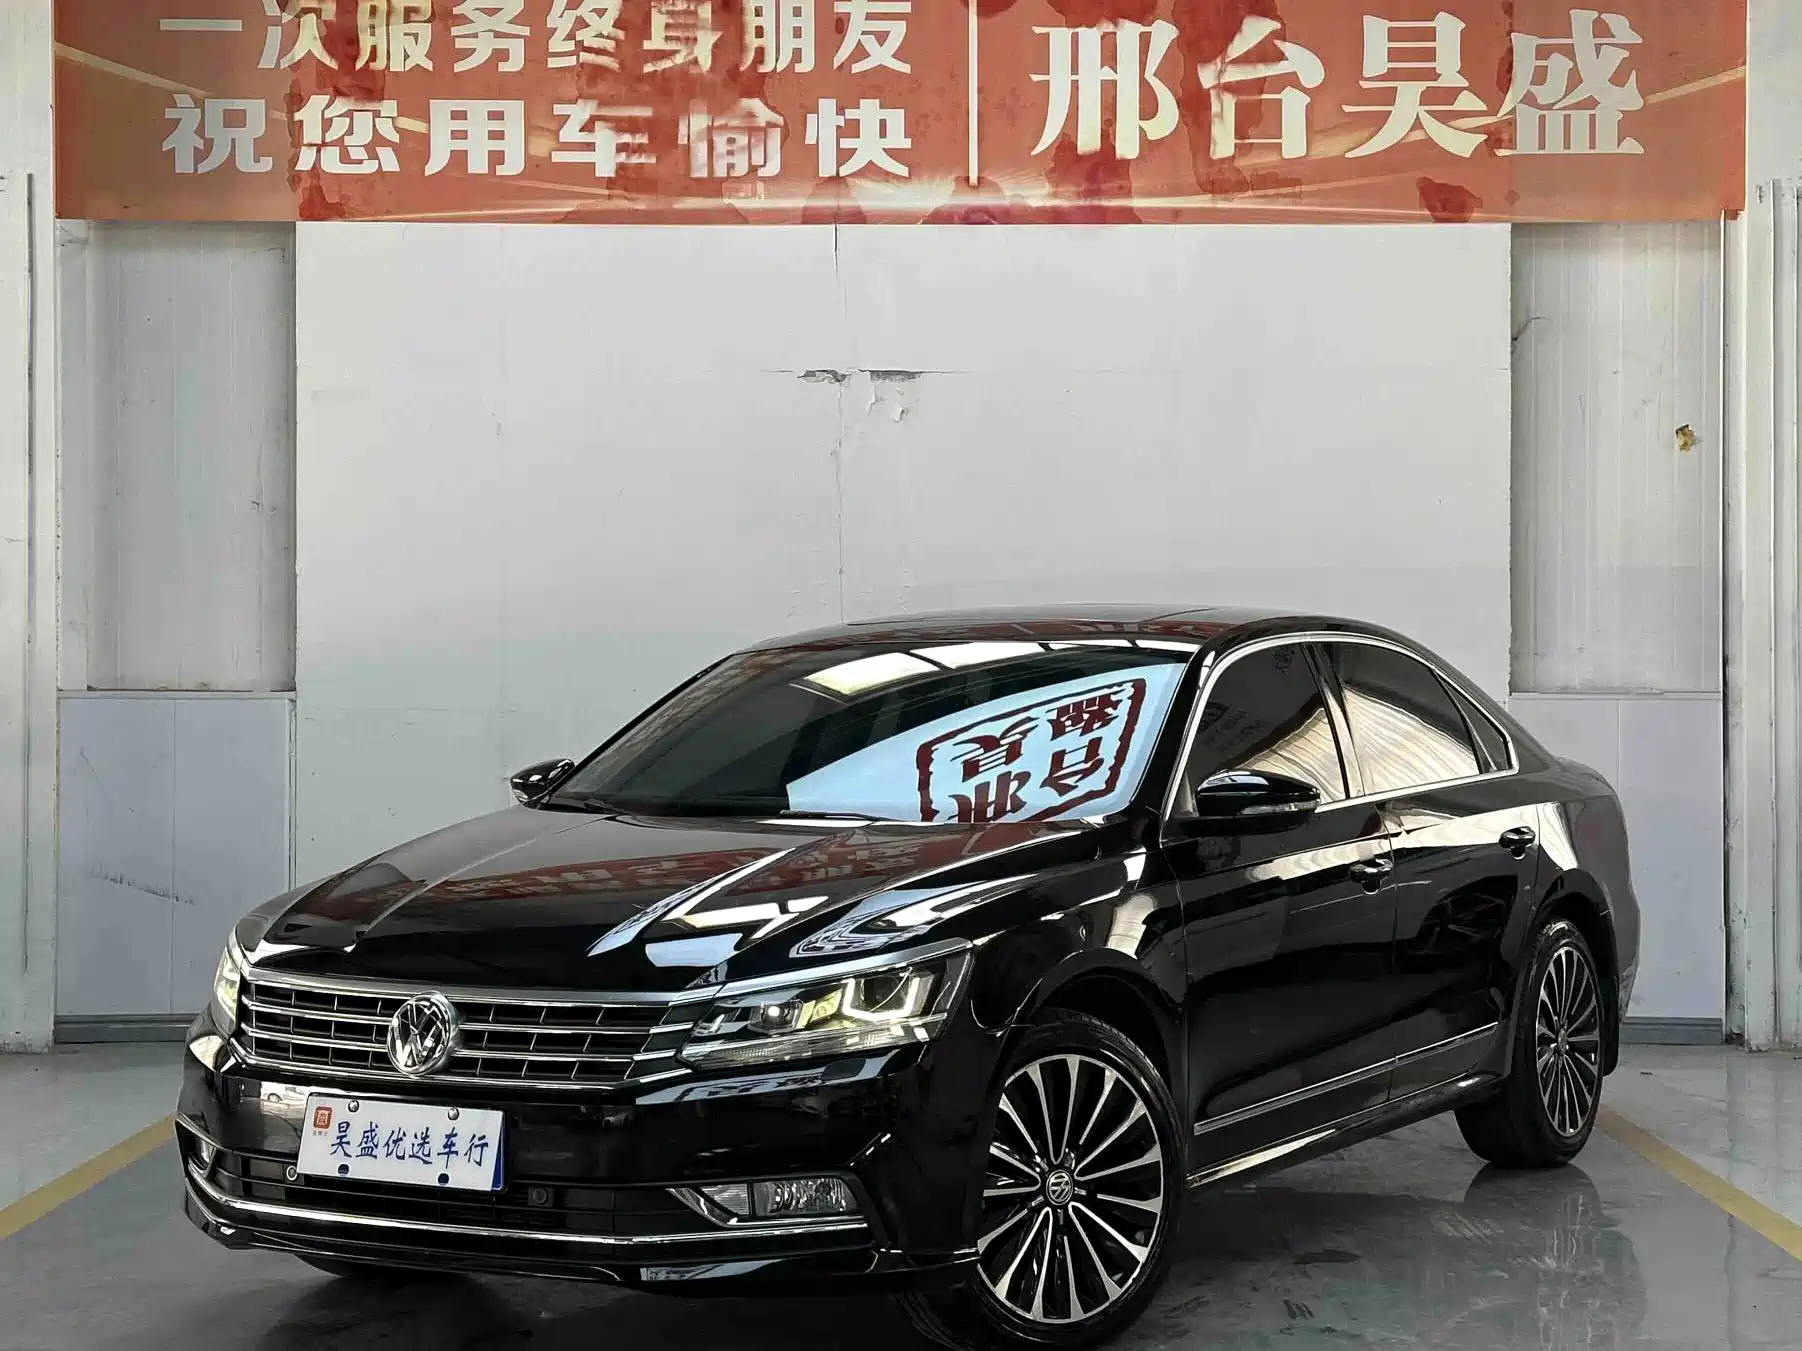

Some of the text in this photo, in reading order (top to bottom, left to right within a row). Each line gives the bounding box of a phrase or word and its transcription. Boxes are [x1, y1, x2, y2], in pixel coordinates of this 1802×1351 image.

[160, 0, 911, 73] 一次服务终身朋友
[1030, 9, 1644, 160] 邢台昊盛
[161, 94, 913, 178] 祝您用车愉快
[329, 1120, 490, 1169] 昊盛优选车行
